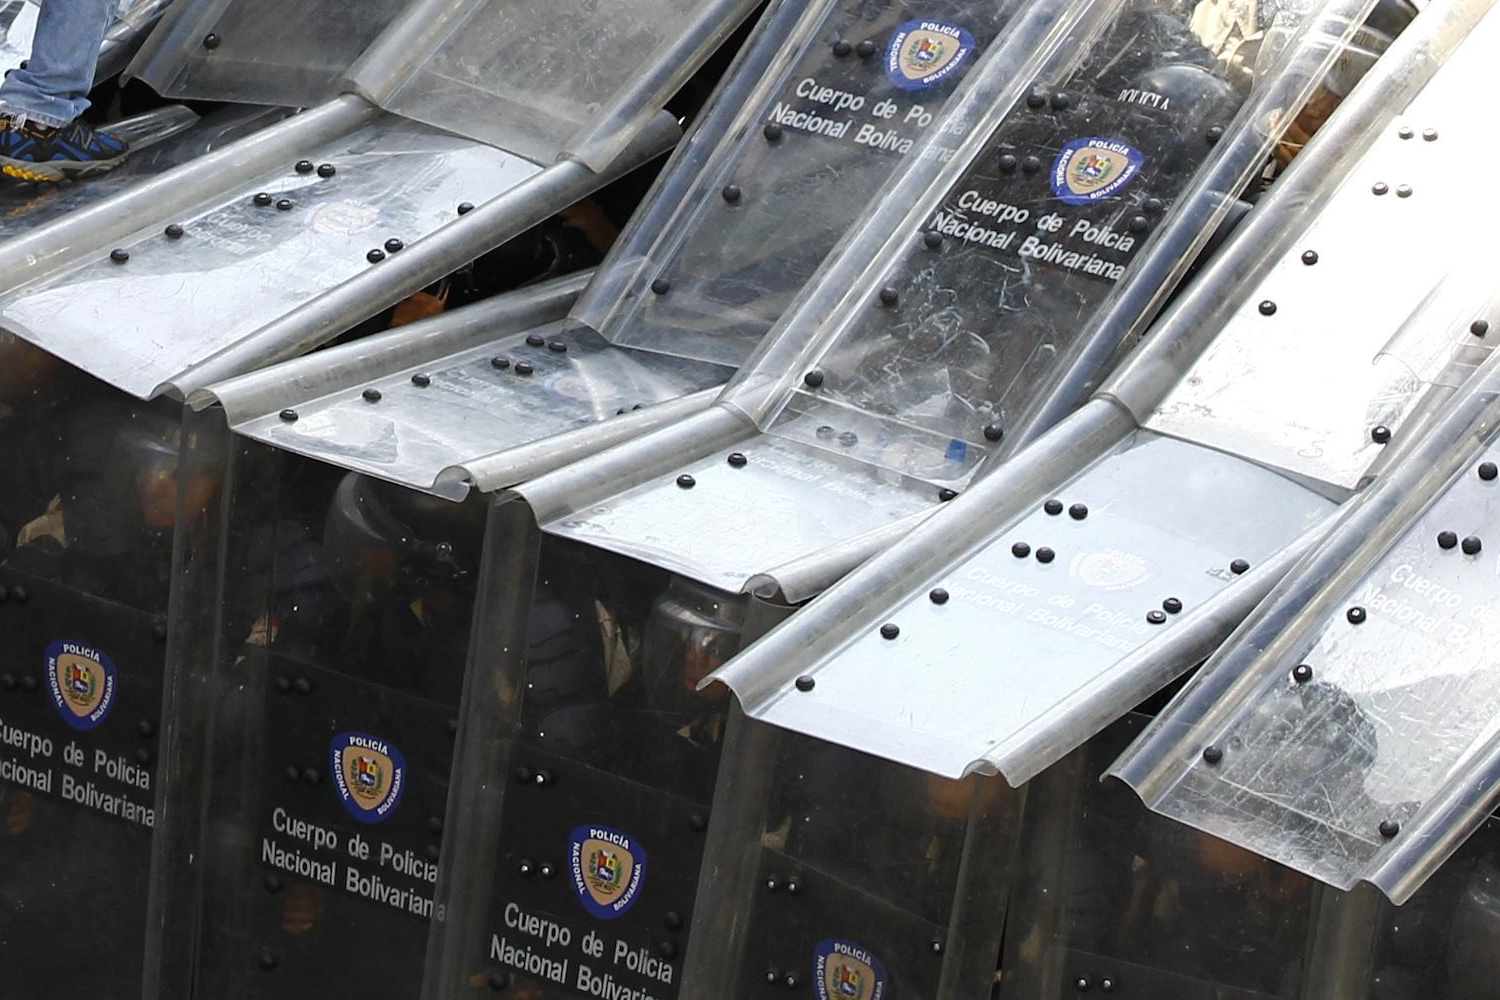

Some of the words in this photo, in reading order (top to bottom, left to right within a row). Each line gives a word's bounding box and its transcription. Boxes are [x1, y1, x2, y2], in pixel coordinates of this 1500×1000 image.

[921, 22, 960, 38] POLICÍA
[796, 78, 865, 112] Cuerpo
[872, 98, 897, 120] de
[768, 103, 853, 139] Nacional
[1089, 140, 1130, 155] POLICÍA
[958, 190, 1030, 225] Cuerpo
[1037, 213, 1063, 233] de
[928, 211, 1016, 250] Nacional
[1018, 236, 1126, 281] Bolivariana
[63, 742, 84, 767] de
[62, 774, 155, 827] Bolivariana
[273, 808, 337, 850] Cuerpo
[348, 835, 369, 860] de
[590, 829, 630, 849] POLICÍA
[262, 838, 336, 885] Nacional
[504, 902, 571, 947] Cuerpo
[581, 931, 604, 957] de
[490, 934, 568, 983] Nacional
